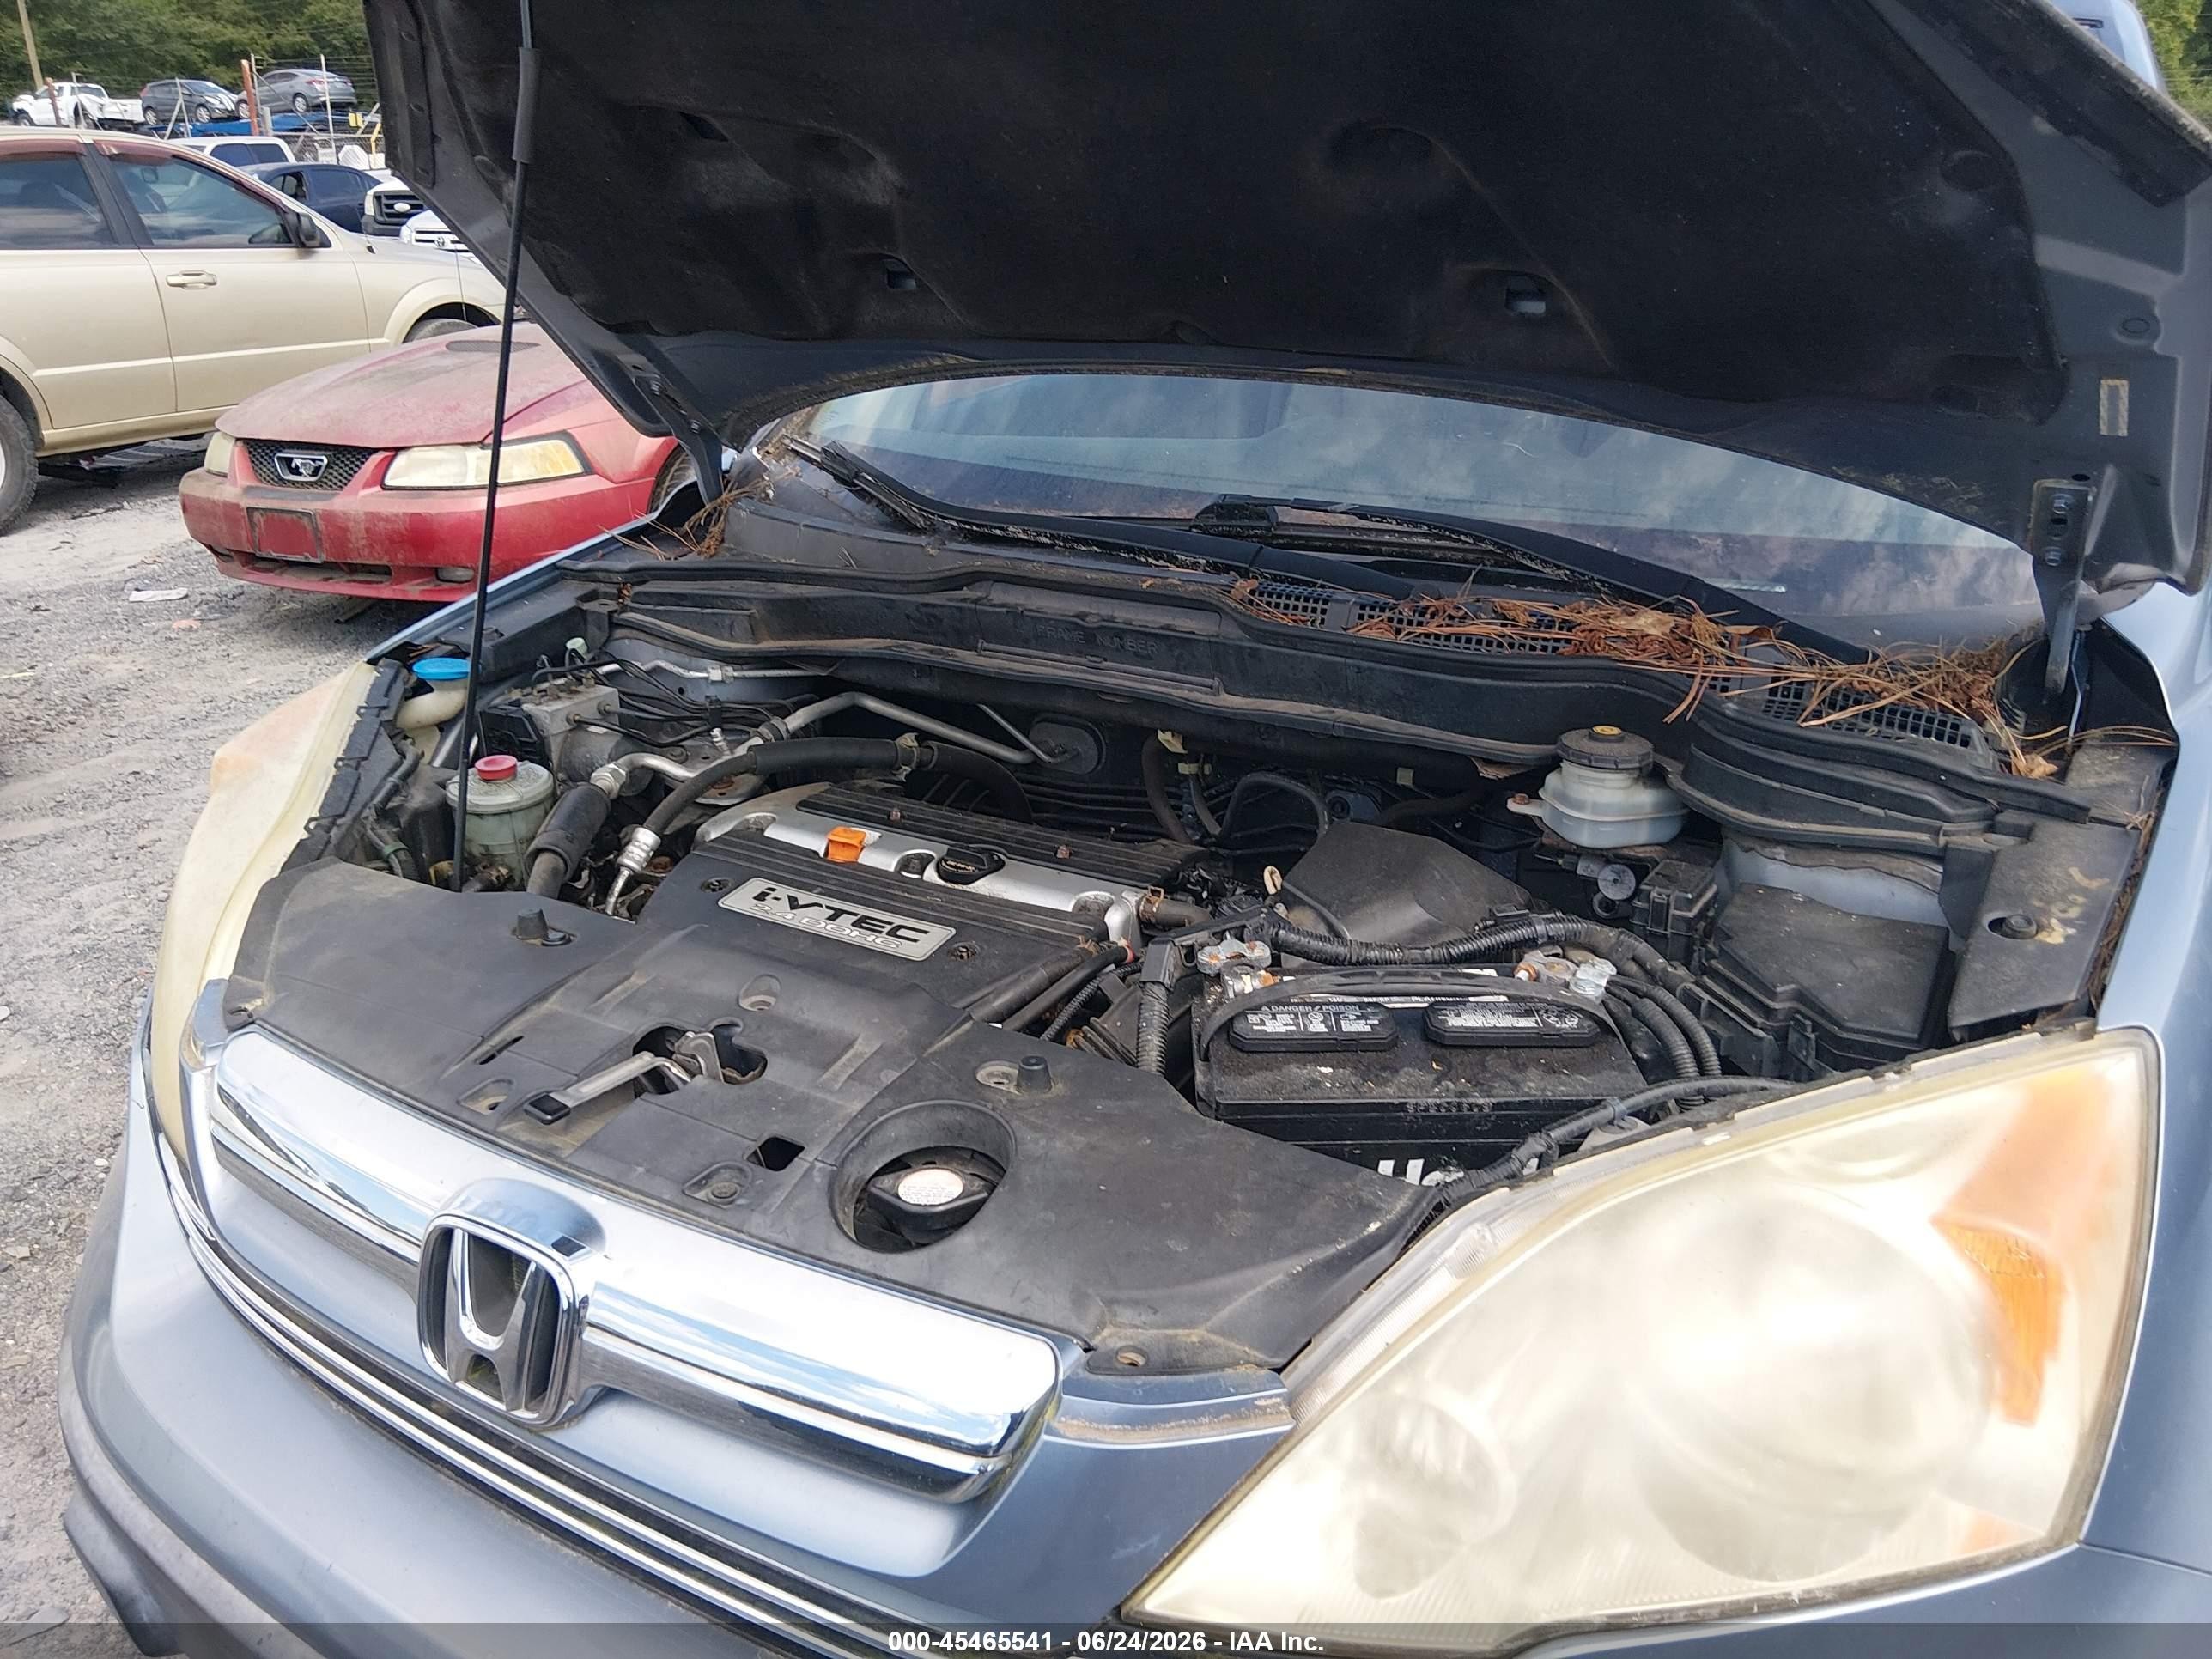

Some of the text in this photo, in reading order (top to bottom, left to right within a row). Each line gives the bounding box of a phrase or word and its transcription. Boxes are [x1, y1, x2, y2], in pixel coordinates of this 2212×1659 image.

[1036, 623, 1161, 655] FRAME NUMBER
[751, 886, 930, 943] i-VTEC
[799, 916, 902, 949] DOHC
